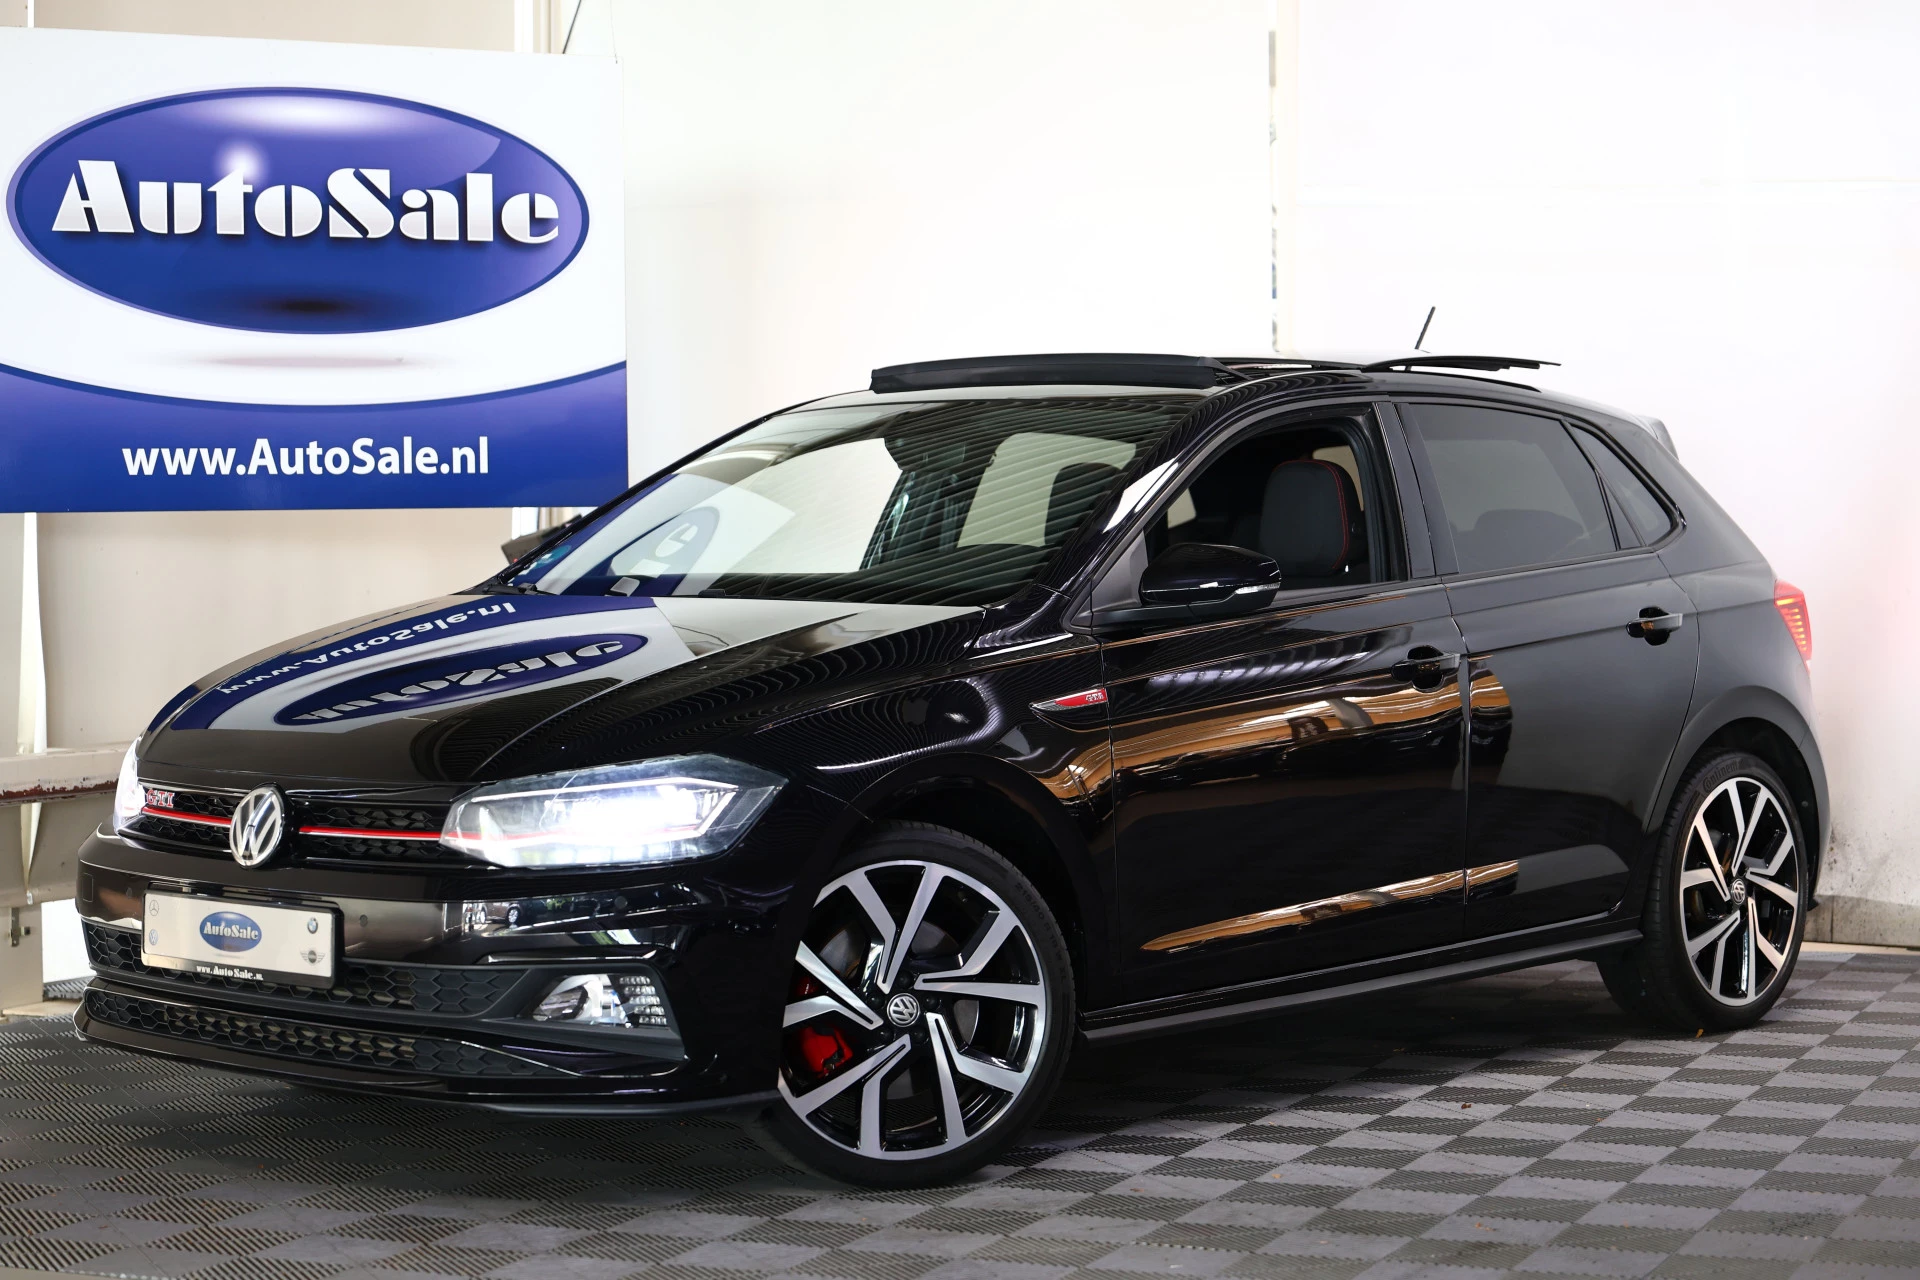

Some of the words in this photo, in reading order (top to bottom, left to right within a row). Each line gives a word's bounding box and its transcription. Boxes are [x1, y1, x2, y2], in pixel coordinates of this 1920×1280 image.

[52, 159, 560, 244] AutoSale
[122, 436, 489, 476] www.AutoSale.nl
[146, 788, 175, 808] GTI
[203, 921, 259, 940] AutoSale
